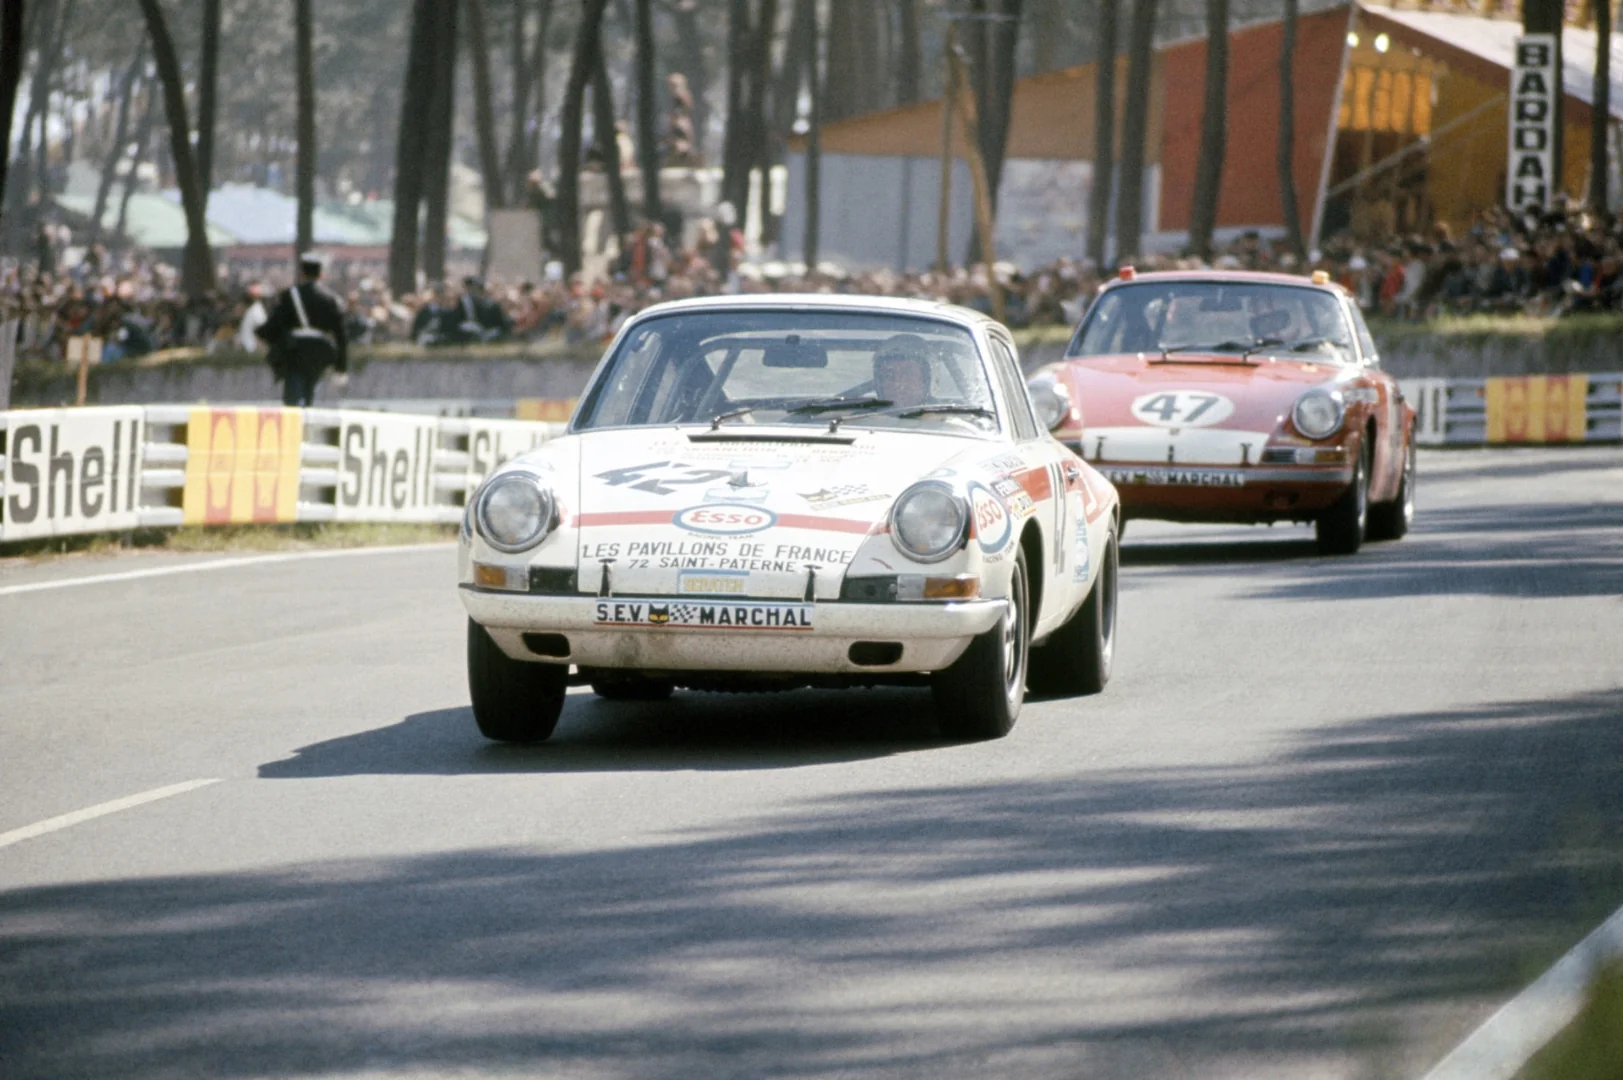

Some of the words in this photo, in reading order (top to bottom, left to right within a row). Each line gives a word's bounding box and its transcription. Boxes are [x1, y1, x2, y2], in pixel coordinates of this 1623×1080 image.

[1140, 394, 1220, 422] 47
[8, 419, 139, 524] Shell
[341, 423, 433, 510] Shell
[1167, 473, 1240, 486] MARCHAL
[582, 542, 621, 559] LES
[627, 541, 728, 556] PAVILLONS
[738, 543, 765, 558] DE
[775, 545, 853, 564] FRANCE
[628, 558, 650, 570] 72
[597, 603, 644, 622] S.E.V.
[700, 606, 812, 626] MARCHAL
